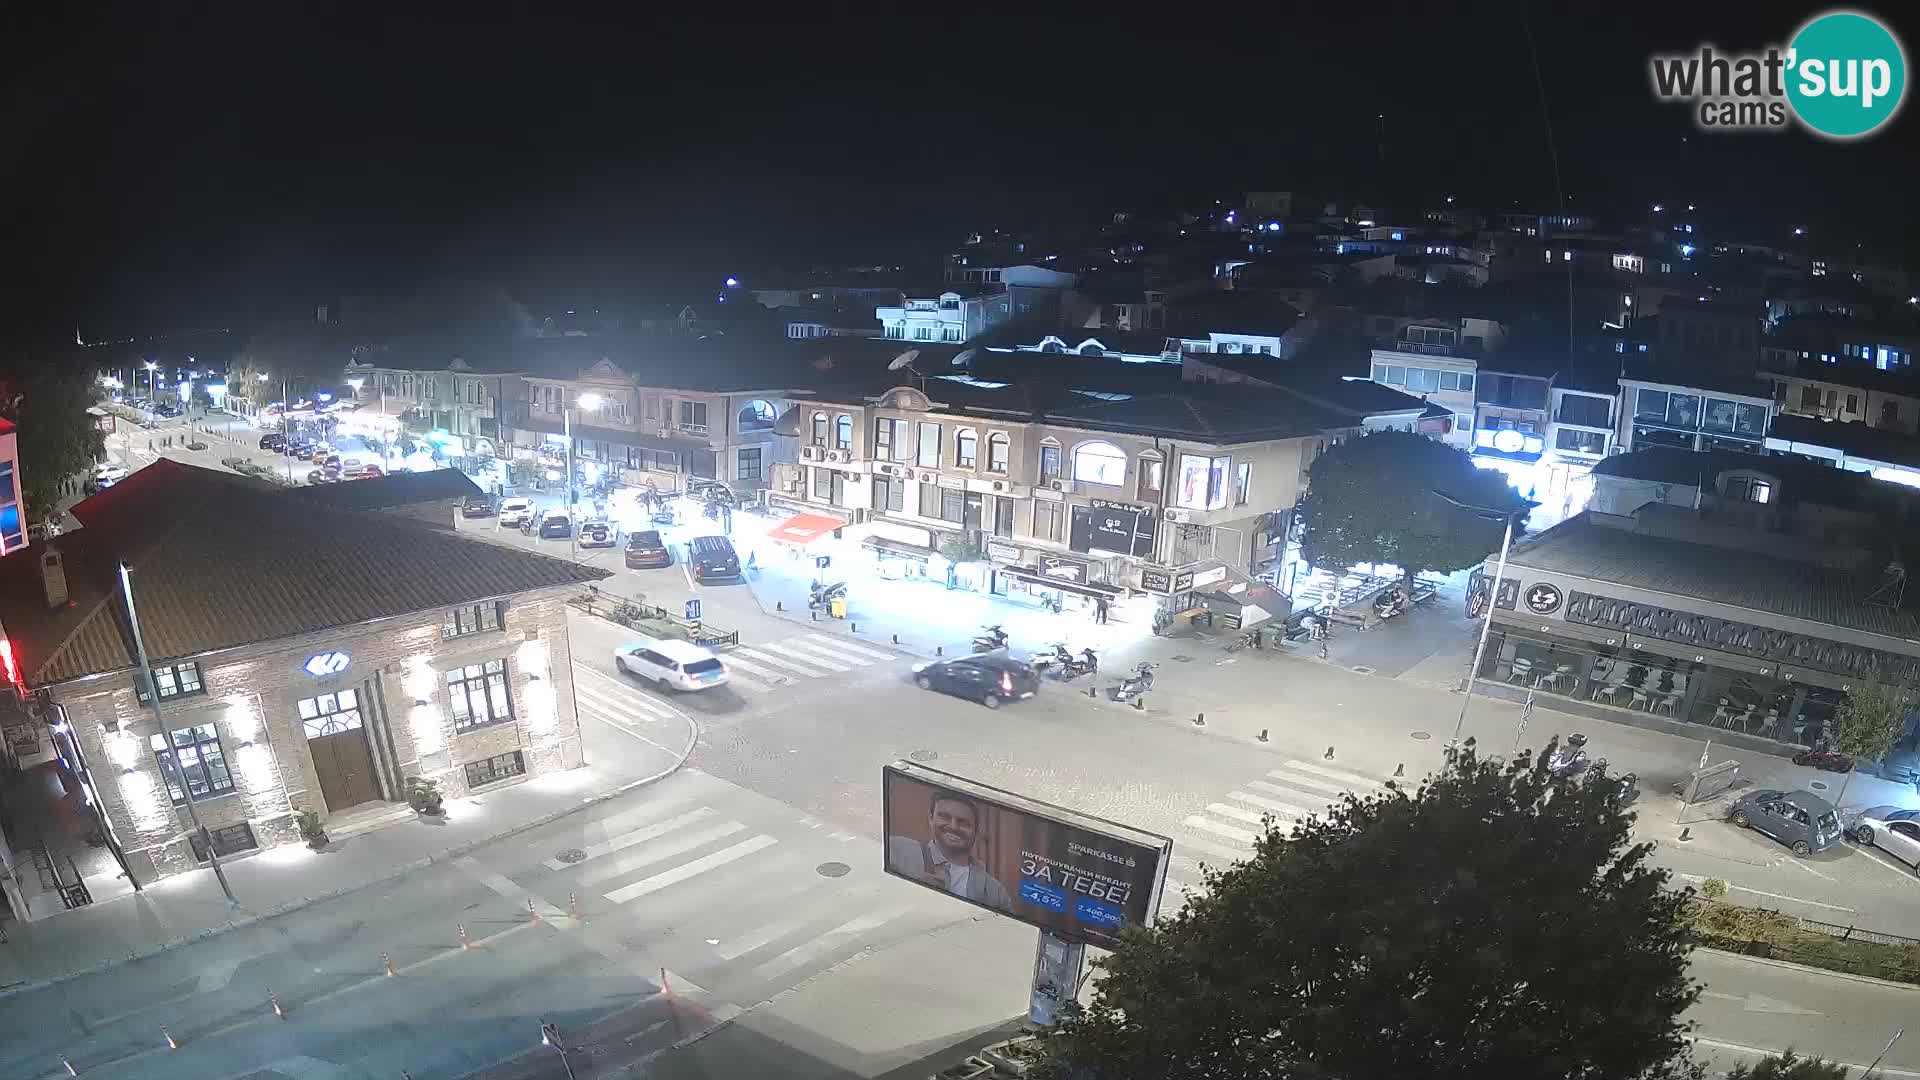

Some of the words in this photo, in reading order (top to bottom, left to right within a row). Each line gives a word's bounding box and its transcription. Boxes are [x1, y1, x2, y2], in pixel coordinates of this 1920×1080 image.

[1068, 842, 1125, 864] SPARKASSE
[1020, 859, 1052, 882] ЗА
[1060, 870, 1131, 905] ТЕБЕ!
